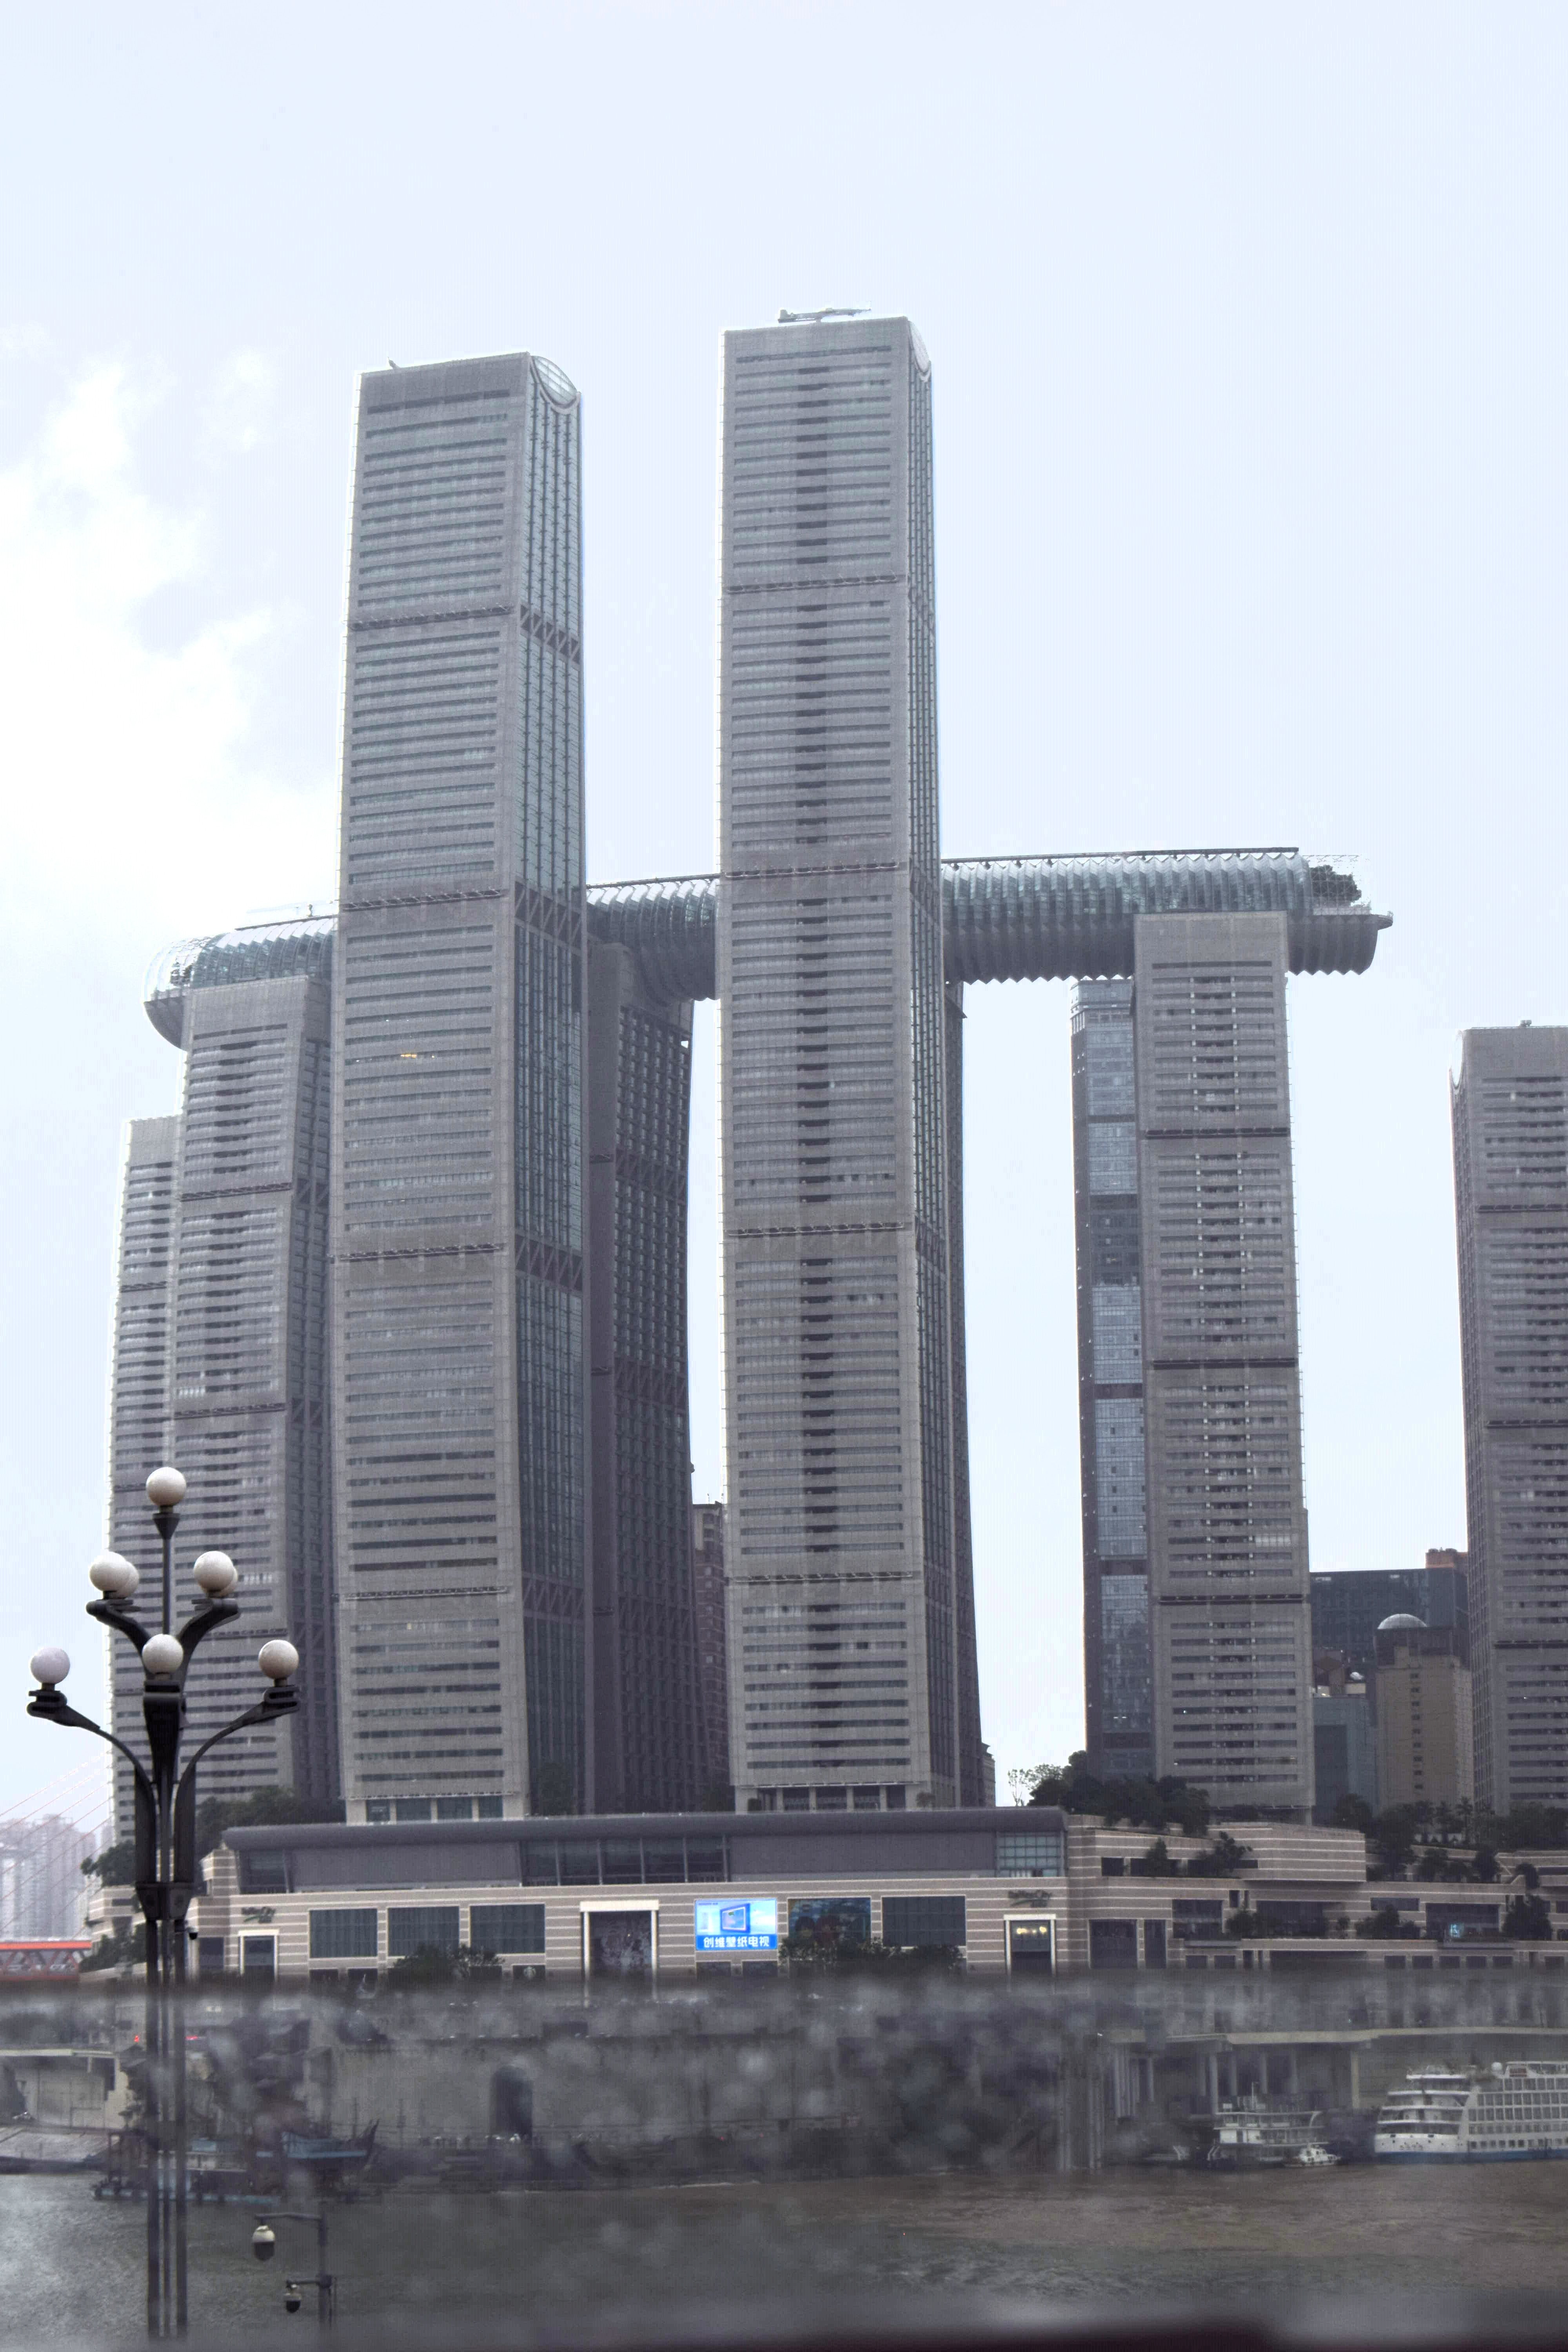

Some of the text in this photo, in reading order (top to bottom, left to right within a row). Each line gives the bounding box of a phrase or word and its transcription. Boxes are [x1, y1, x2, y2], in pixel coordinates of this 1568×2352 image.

[704, 1936, 769, 1947] 创维壁纸电视
